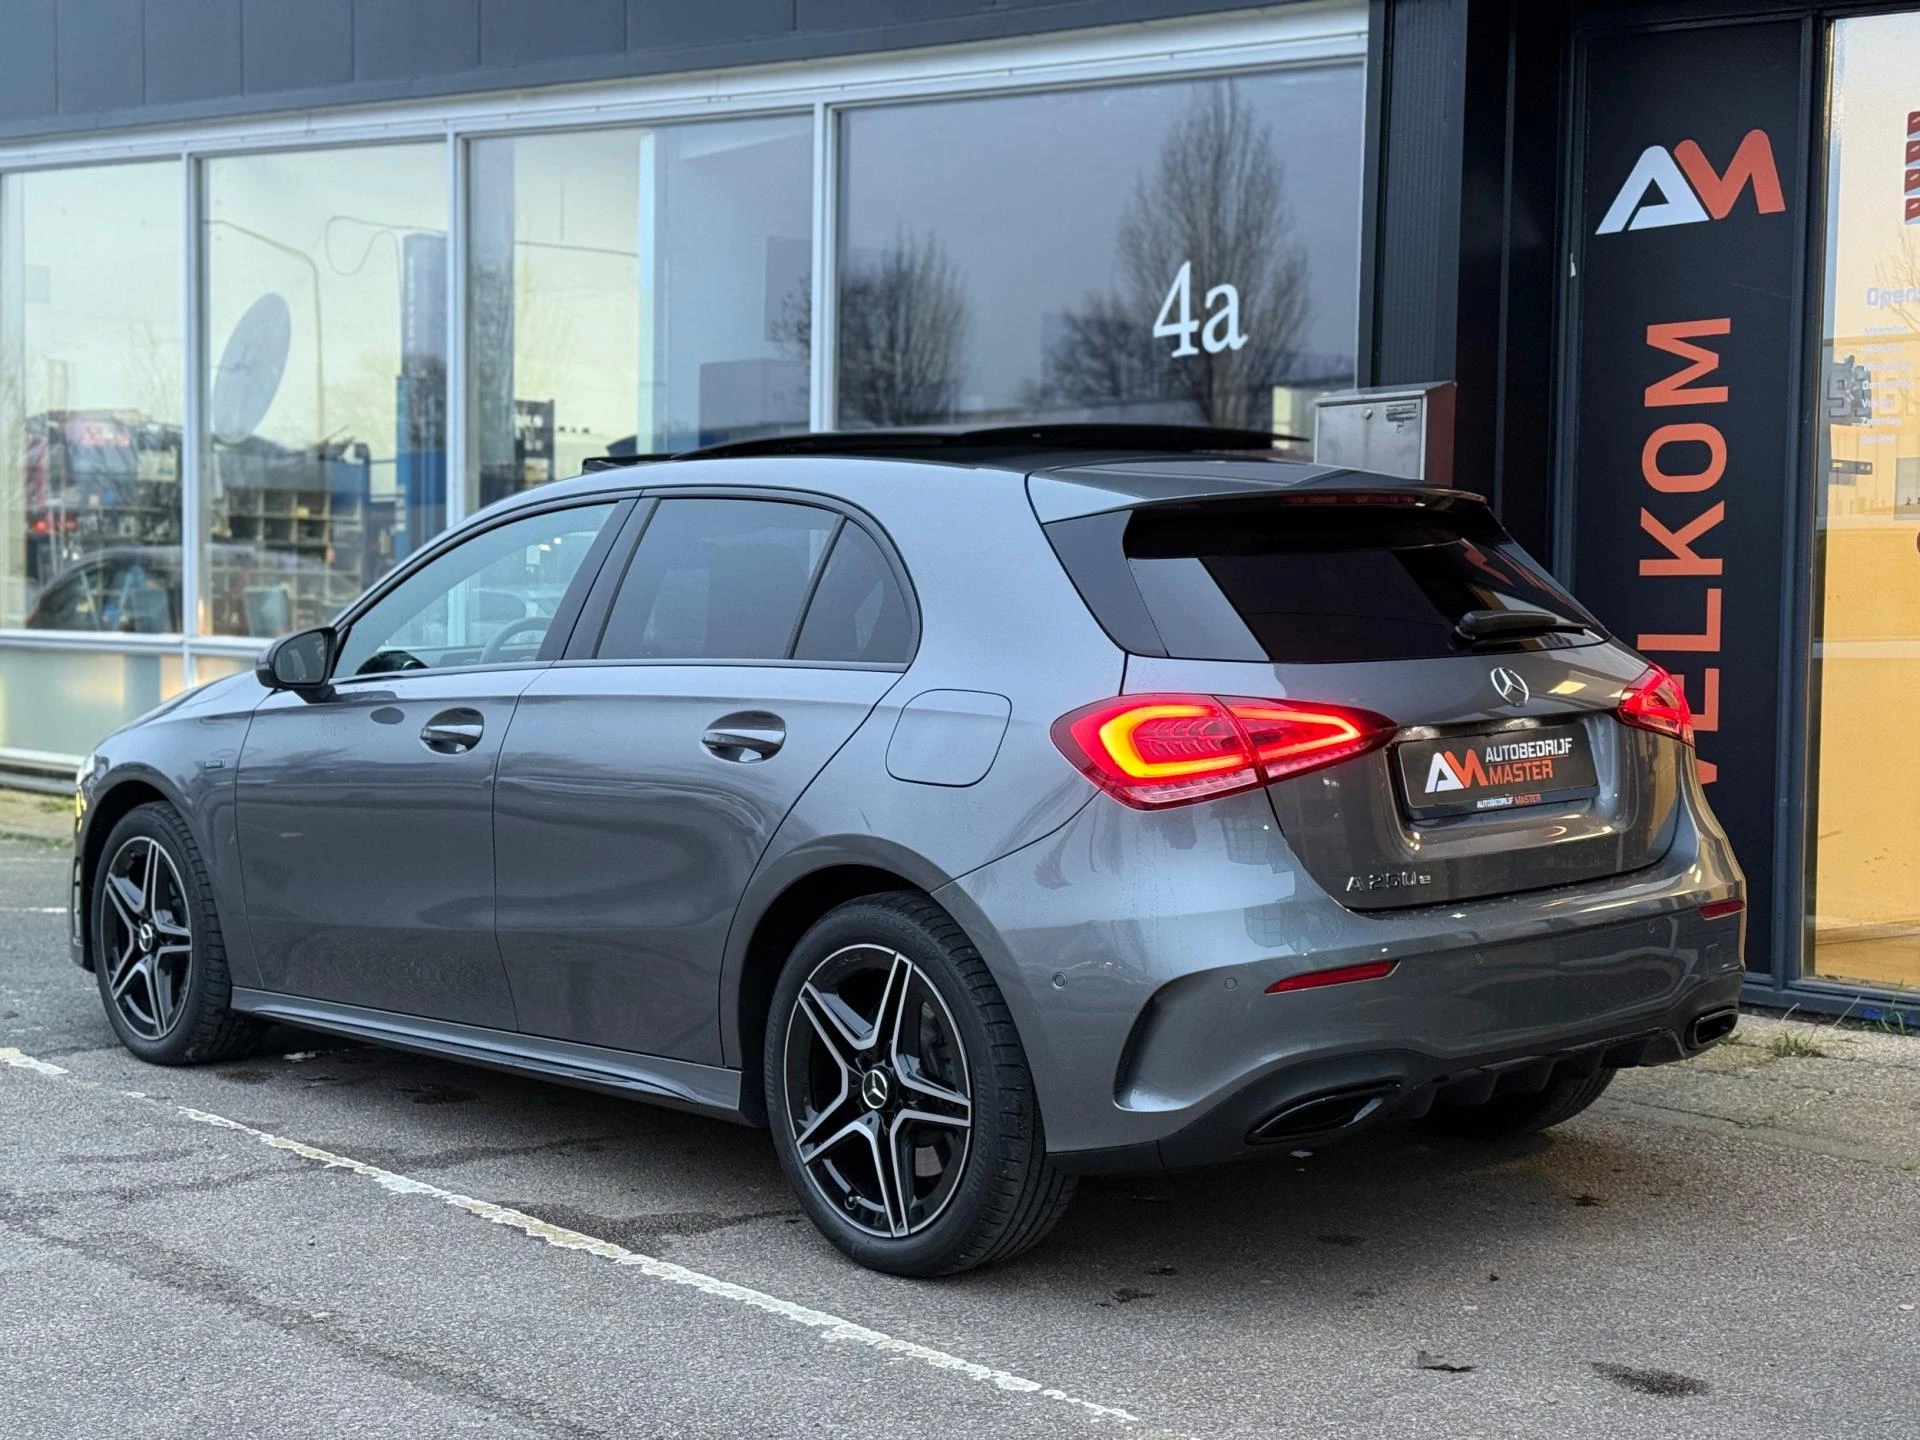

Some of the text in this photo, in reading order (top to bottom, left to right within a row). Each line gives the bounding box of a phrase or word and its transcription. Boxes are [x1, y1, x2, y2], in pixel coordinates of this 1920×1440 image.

[1595, 128, 1786, 235] AM
[1152, 260, 1249, 358] 4a
[1636, 317, 1732, 785] ELKOM
[1484, 737, 1573, 763] AUTOBEDRIJF
[1424, 747, 1489, 794] AM
[1488, 759, 1553, 786] MASTER
[1514, 793, 1542, 806] MASTER
[1345, 876, 1363, 892] A
